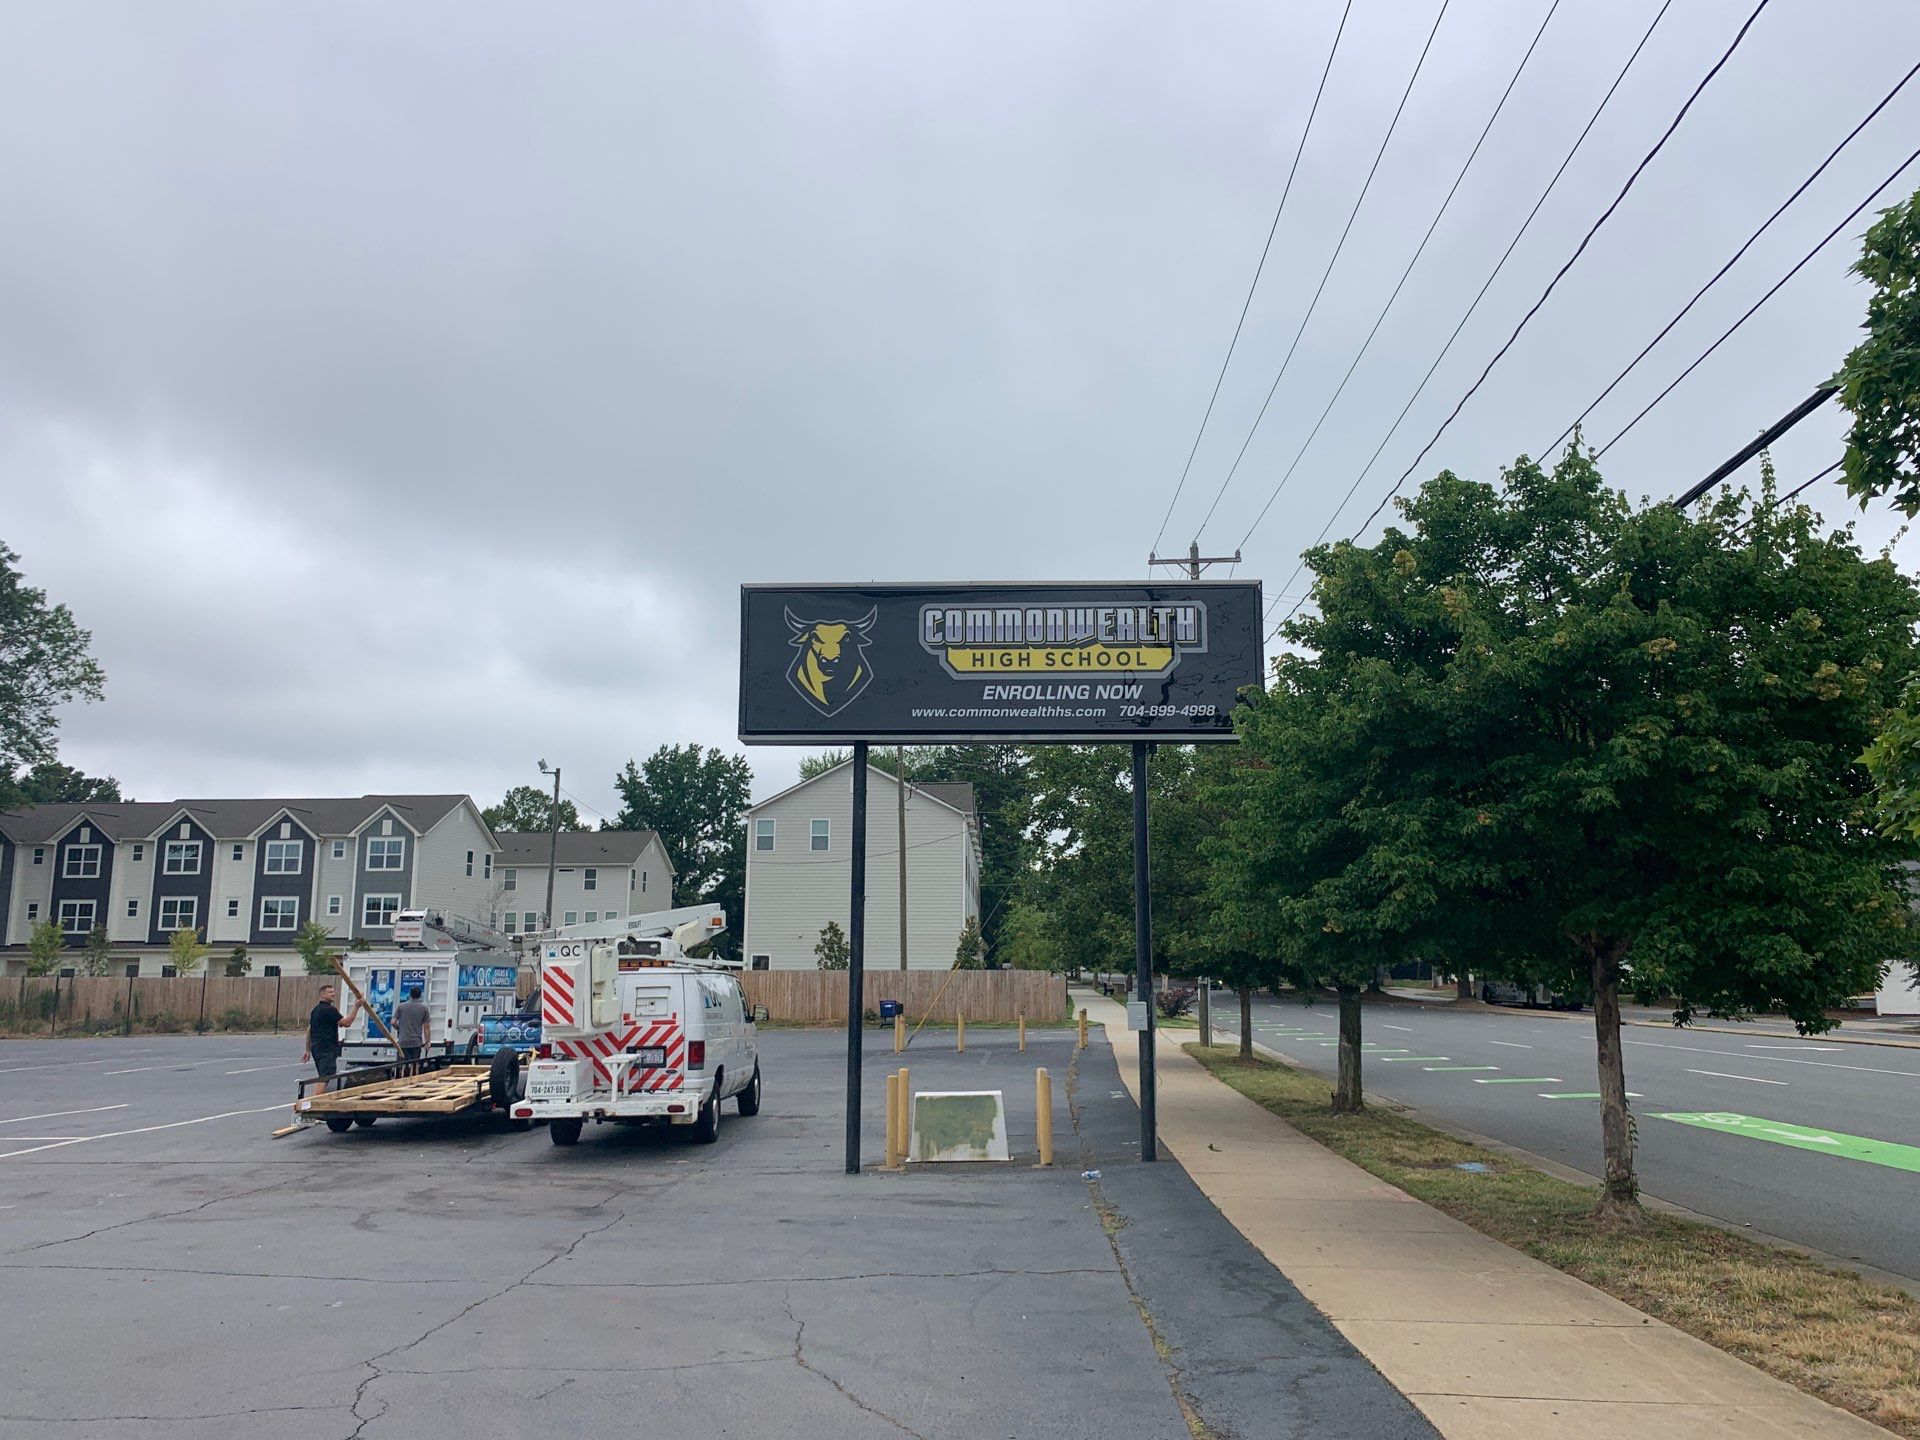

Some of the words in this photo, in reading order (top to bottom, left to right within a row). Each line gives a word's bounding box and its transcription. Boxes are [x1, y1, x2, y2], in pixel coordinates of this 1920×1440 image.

[924, 606, 1198, 645] COMMONWEALTH
[971, 652, 1031, 667] HIGH
[1044, 651, 1147, 666] SCHOOL
[982, 685, 1088, 700] ENROLLING
[1093, 684, 1144, 699] NOW
[911, 704, 1106, 717] www.commonwealthhs.com
[1118, 702, 1216, 717] 704-899-4998
[560, 945, 580, 957] QC
[411, 970, 426, 979] QC
[477, 967, 492, 987] QC
[508, 1027, 534, 1040] QC
[531, 1085, 570, 1094] 704-247-5533
